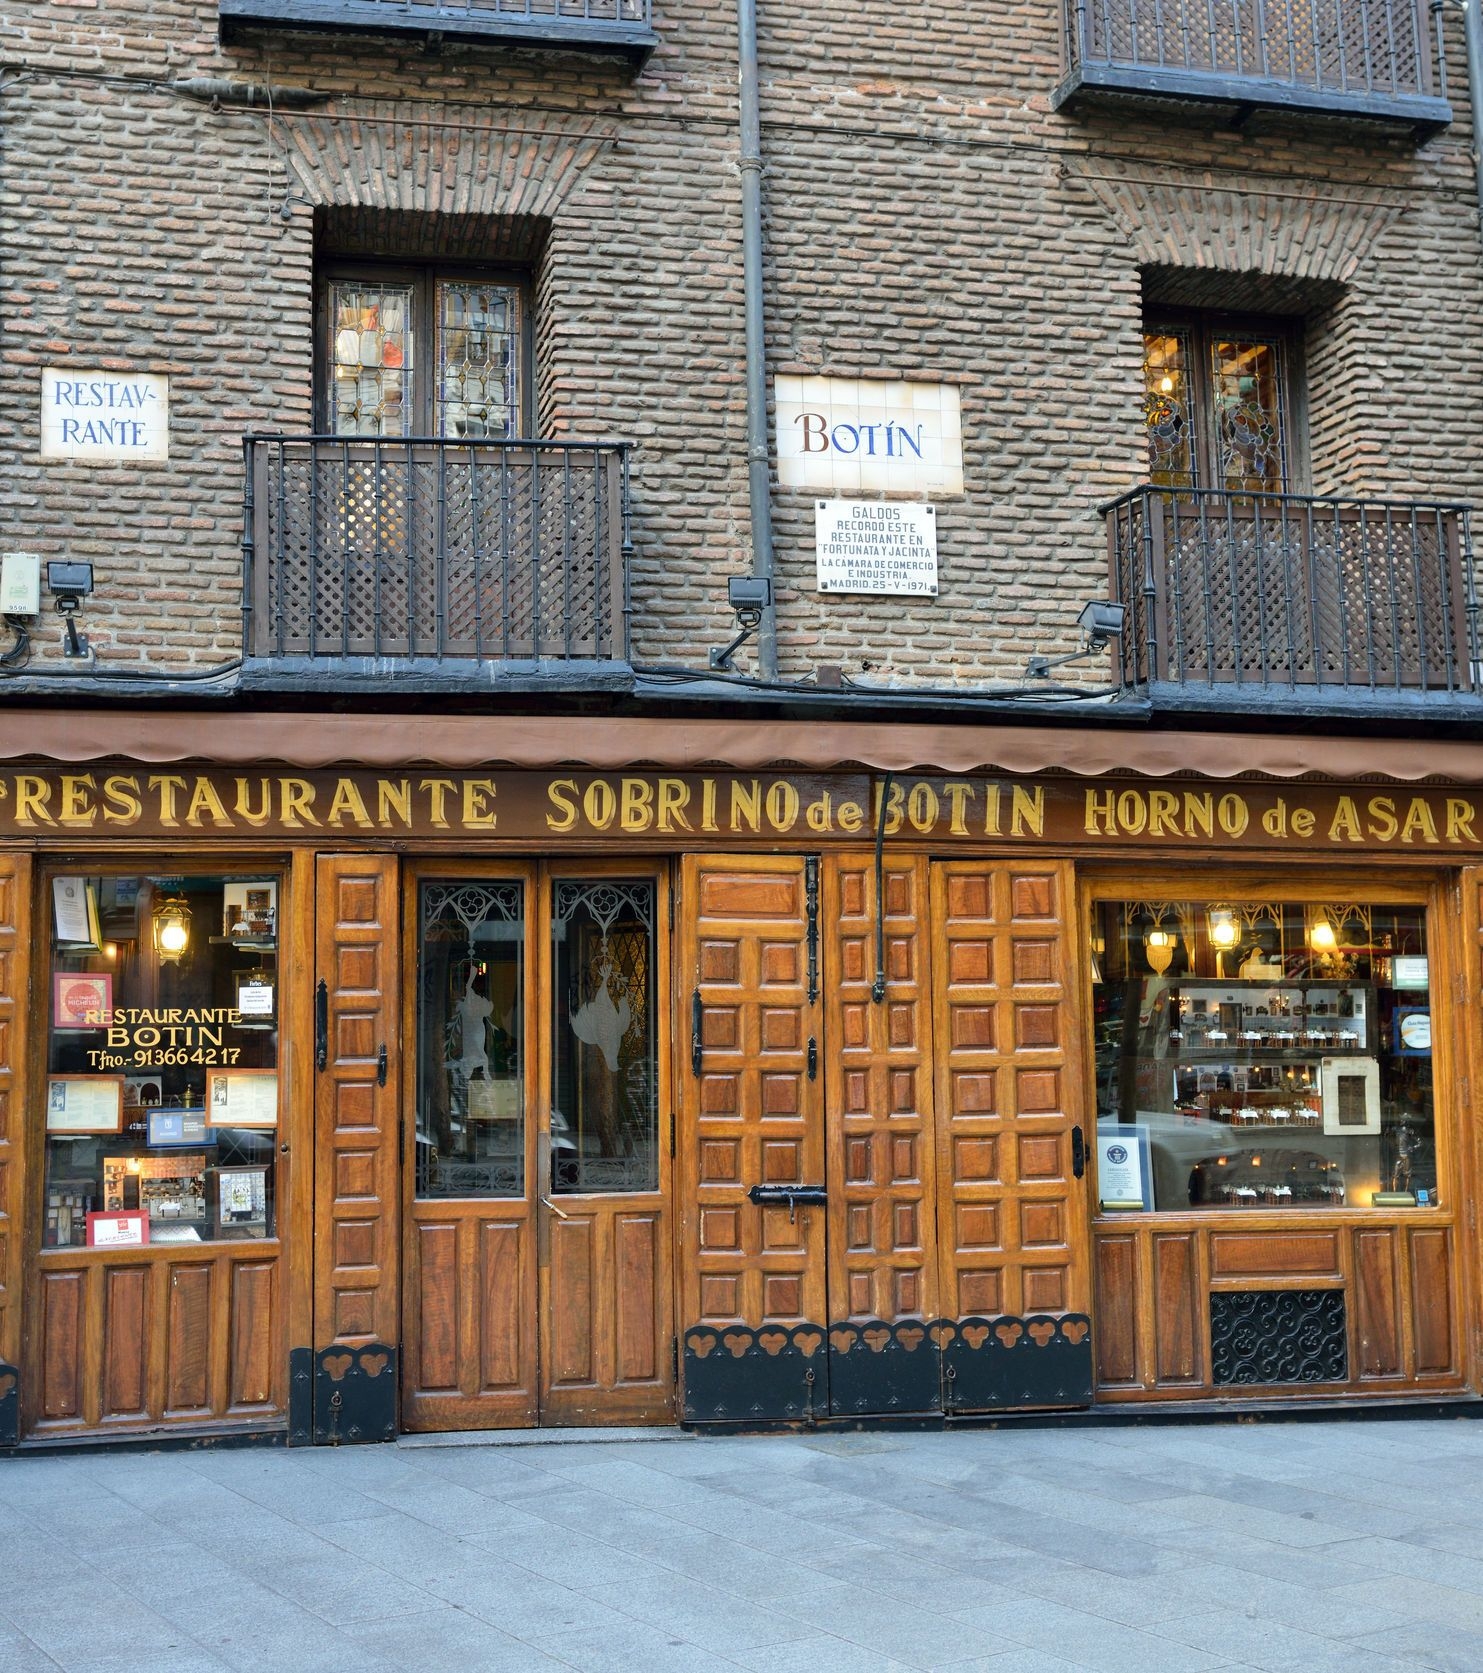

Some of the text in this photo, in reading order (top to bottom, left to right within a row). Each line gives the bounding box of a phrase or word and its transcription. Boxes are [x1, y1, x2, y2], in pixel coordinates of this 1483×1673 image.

[61, 418, 148, 446] RANTE
[852, 506, 900, 520] GALDOS
[837, 520, 916, 533] RECORDÓ ESTE
[831, 532, 923, 545] RESTAURANTE EN
[881, 546, 887, 556] Y
[821, 558, 833, 567] LA
[874, 560, 886, 569] DE
[887, 561, 934, 570] COMERCIO
[848, 569, 912, 580] E INDUSTRIA.
[13, 773, 1482, 843] RESTAURANTE SOBRINO de BOTIN HORNO de ASAR
[85, 1008, 243, 1024] RESTAURANTE
[107, 1026, 223, 1047] BOTIN
